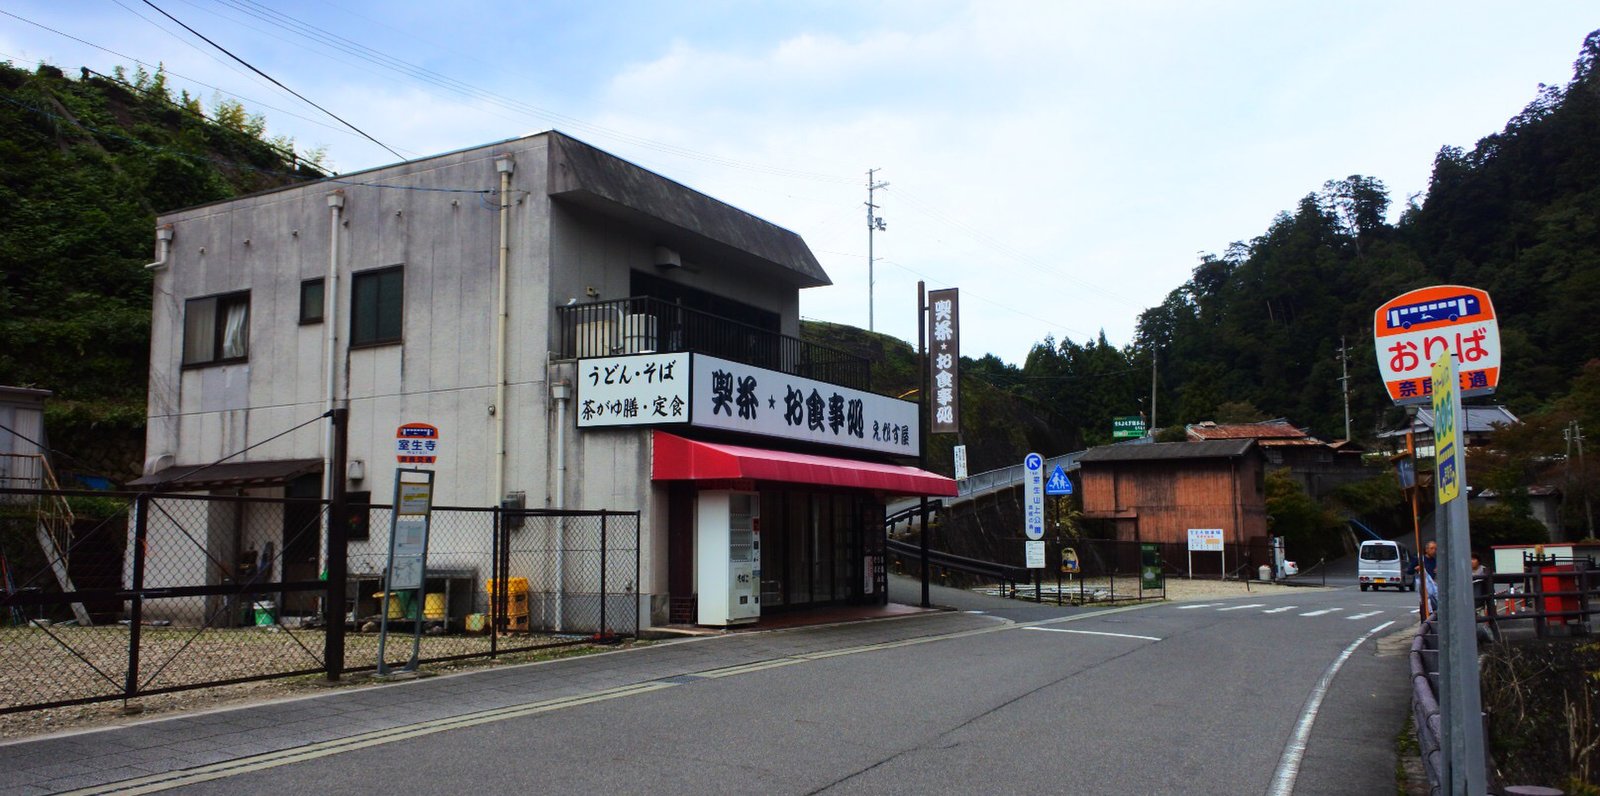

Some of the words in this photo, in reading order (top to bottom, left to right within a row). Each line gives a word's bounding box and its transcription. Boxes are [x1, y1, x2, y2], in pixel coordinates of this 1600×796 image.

[1388, 328, 1489, 372] おりば
[589, 360, 676, 386] うどん・そば
[1399, 370, 1488, 397] 奈良通
[936, 353, 953, 423] お食事処
[582, 394, 685, 421] 茶がゆ膳・定食
[712, 369, 759, 420] 喫茶
[784, 384, 864, 438] お食事処
[399, 440, 436, 451] 室生寺
